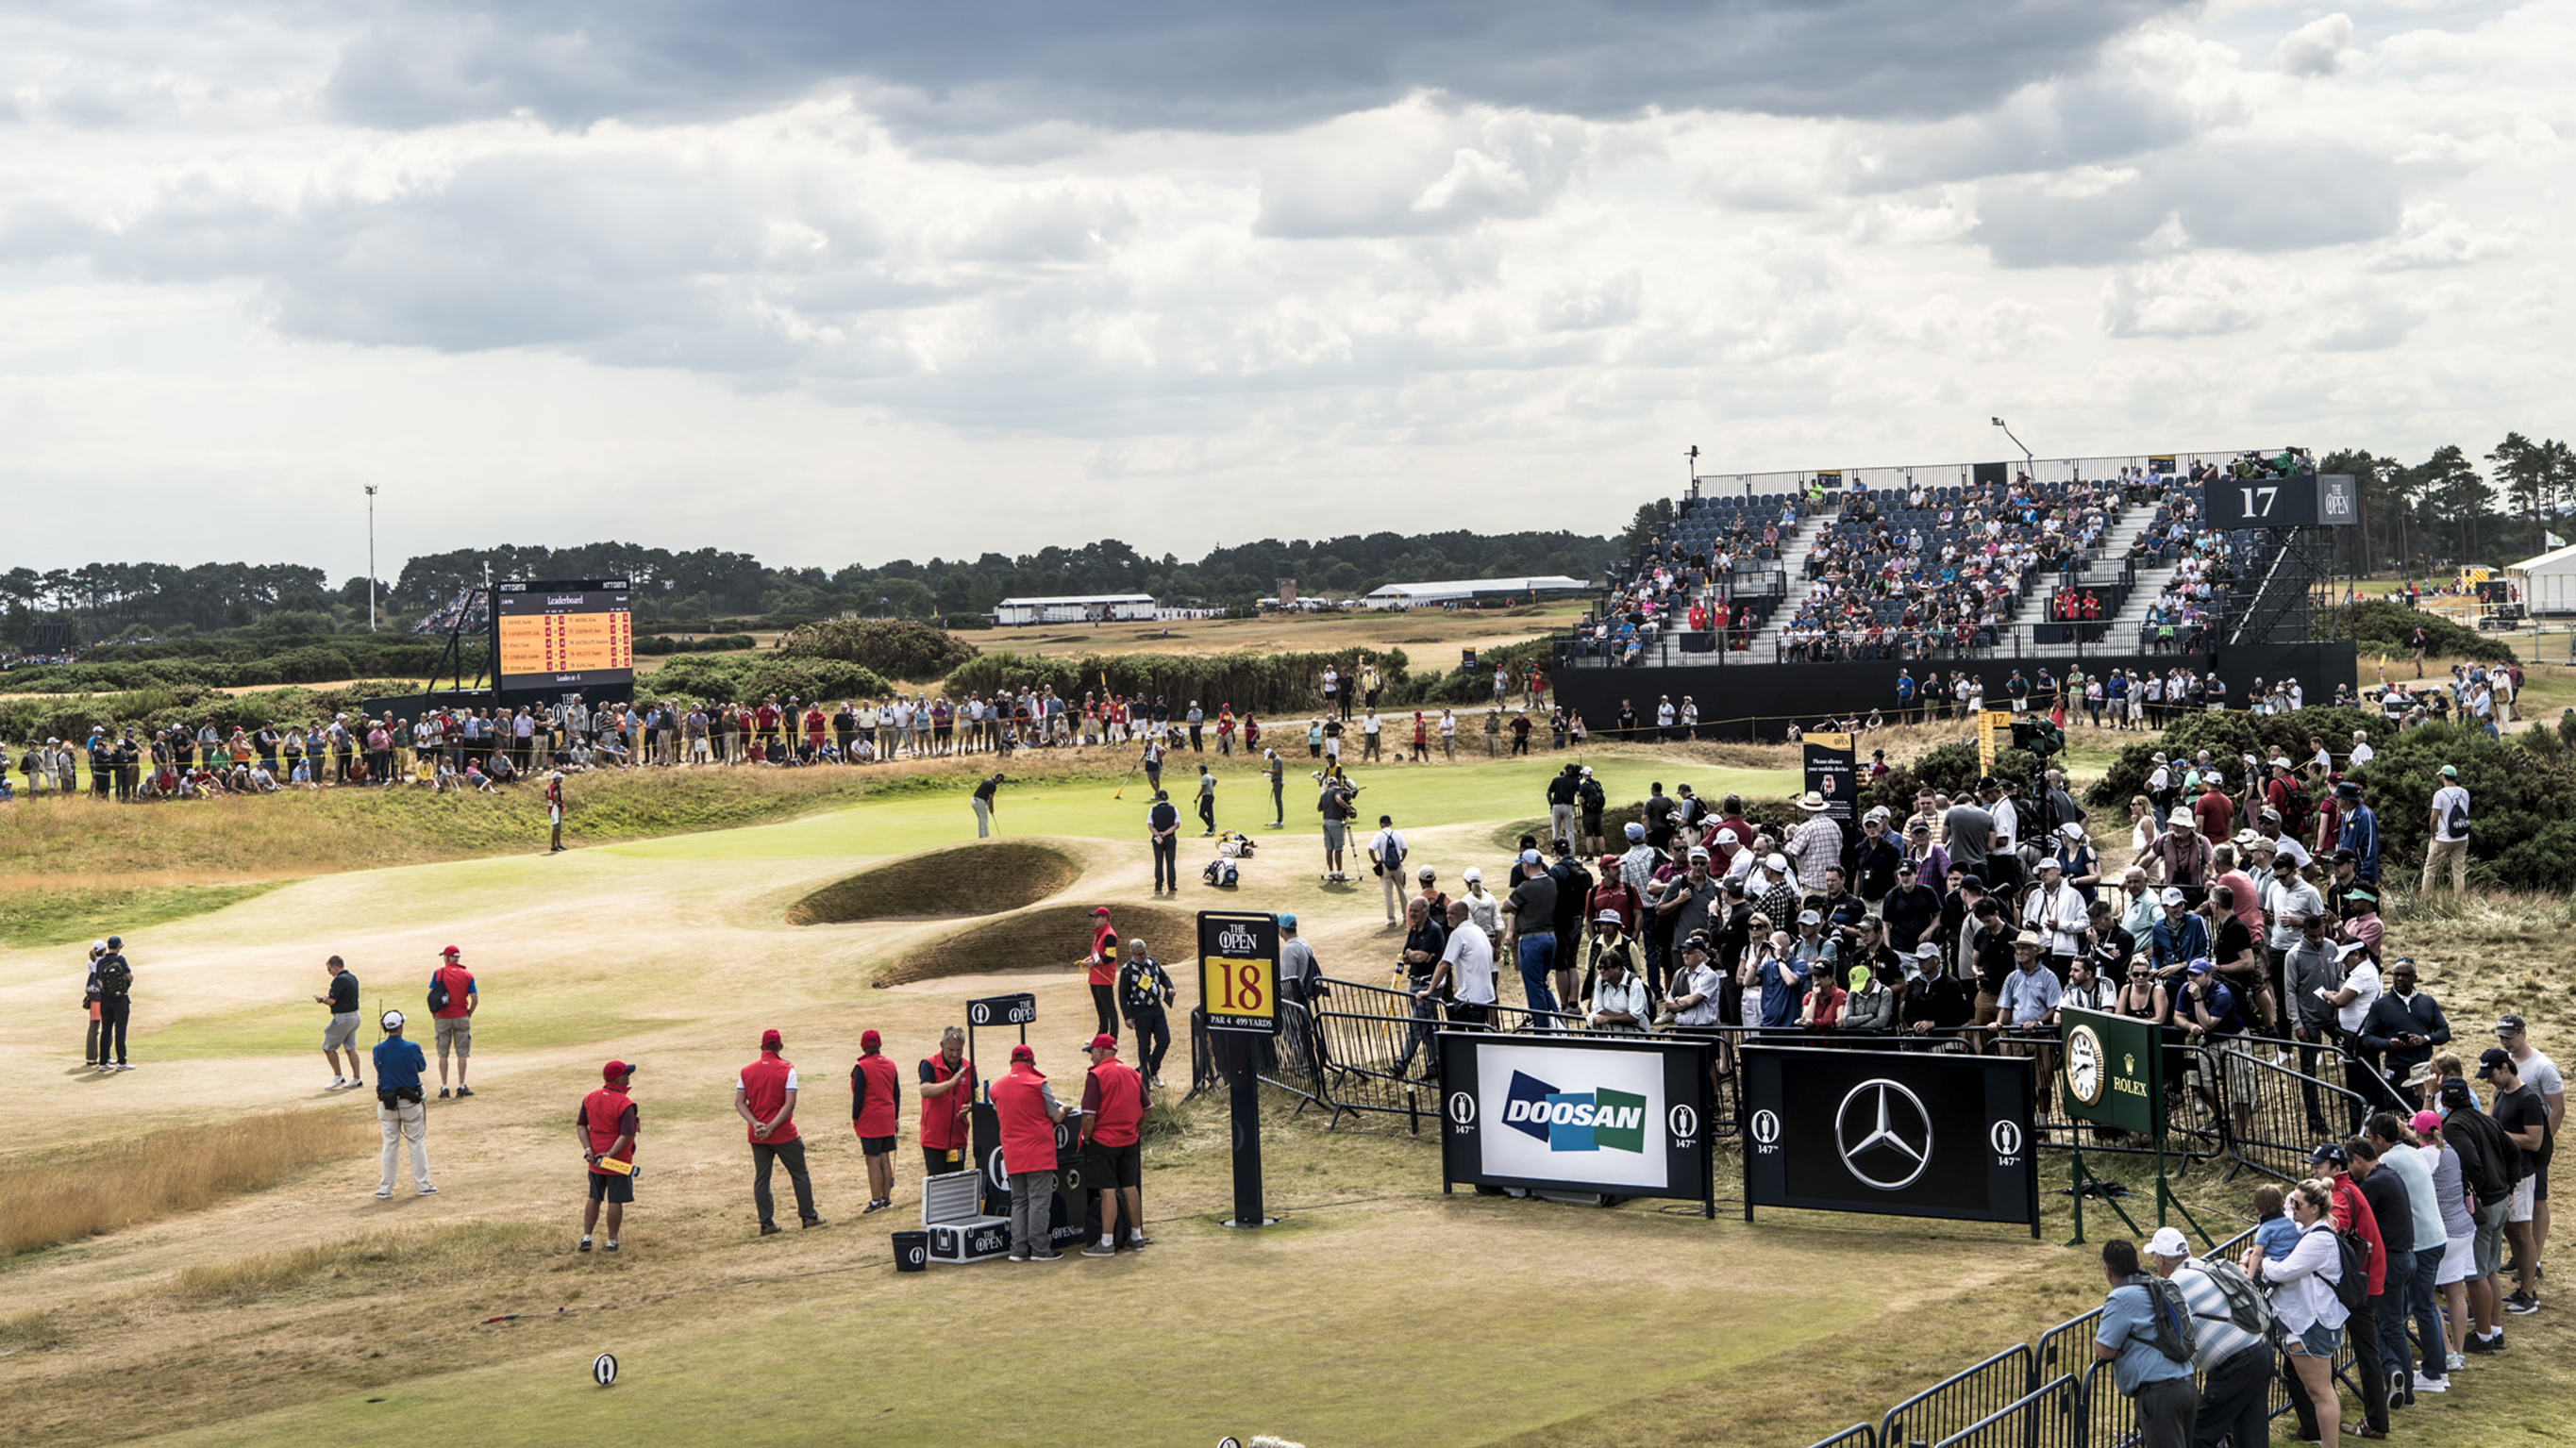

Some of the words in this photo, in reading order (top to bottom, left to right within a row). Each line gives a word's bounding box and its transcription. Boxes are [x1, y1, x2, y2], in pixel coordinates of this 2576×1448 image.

[2332, 484, 2342, 495] THE
[2239, 486, 2278, 518] 17
[2325, 492, 2350, 515] OPEN
[547, 594, 583, 605] Leaderboard
[1992, 713, 2005, 724] 17
[1229, 924, 1246, 934] THE
[1218, 930, 1257, 950] OPEN
[1219, 963, 1263, 1010] 18
[1019, 1000, 1031, 1009] THE
[1211, 1015, 1226, 1024] PAR
[1227, 1016, 1231, 1024] 4
[1235, 1017, 1248, 1026] 499
[1248, 1018, 1273, 1028] YARDS
[2113, 1076, 2148, 1097] ROLEX
[1507, 1099, 1643, 1129] DOOSAN
[983, 1229, 995, 1239] THE
[976, 1235, 1003, 1252] OPEN
